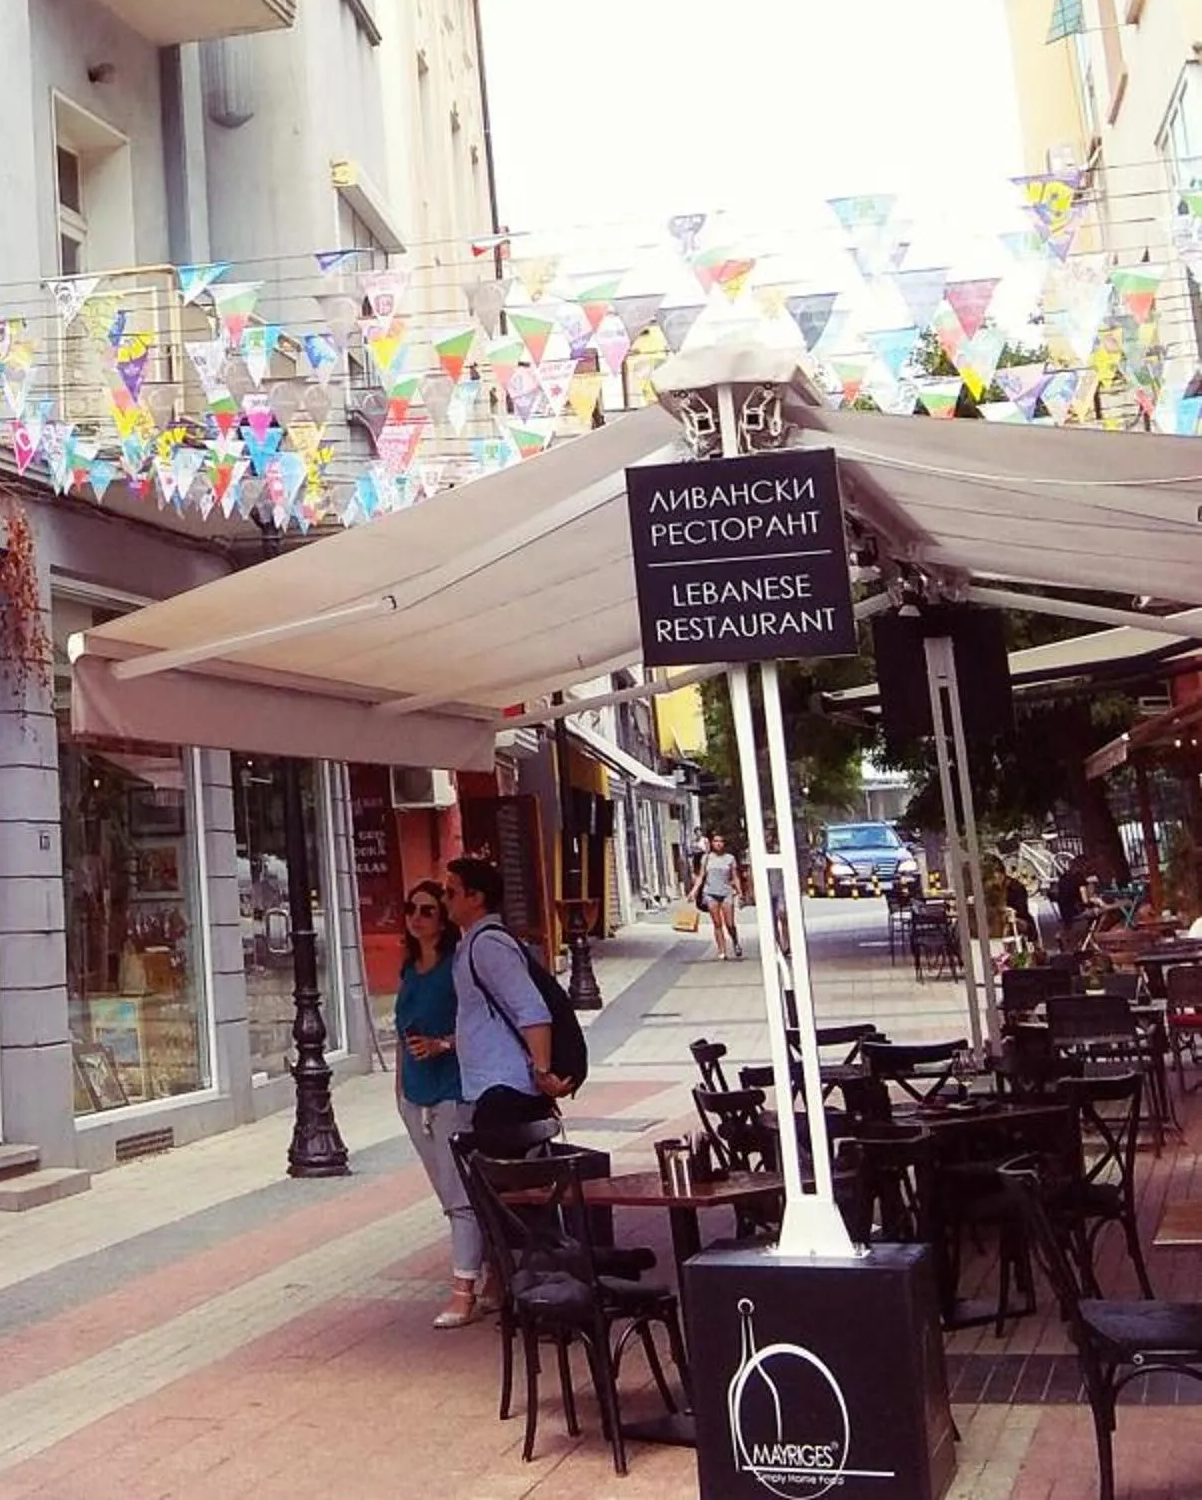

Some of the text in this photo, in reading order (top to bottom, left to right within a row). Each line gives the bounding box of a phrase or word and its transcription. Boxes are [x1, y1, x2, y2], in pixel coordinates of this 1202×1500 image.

[649, 476, 815, 514] ЛИВАНСКИ
[651, 510, 820, 547] РЕСТОРАНТ
[672, 573, 813, 608] LEBANESE
[655, 606, 836, 643] RESTAURANT
[753, 1443, 835, 1468] MAYRIGES
